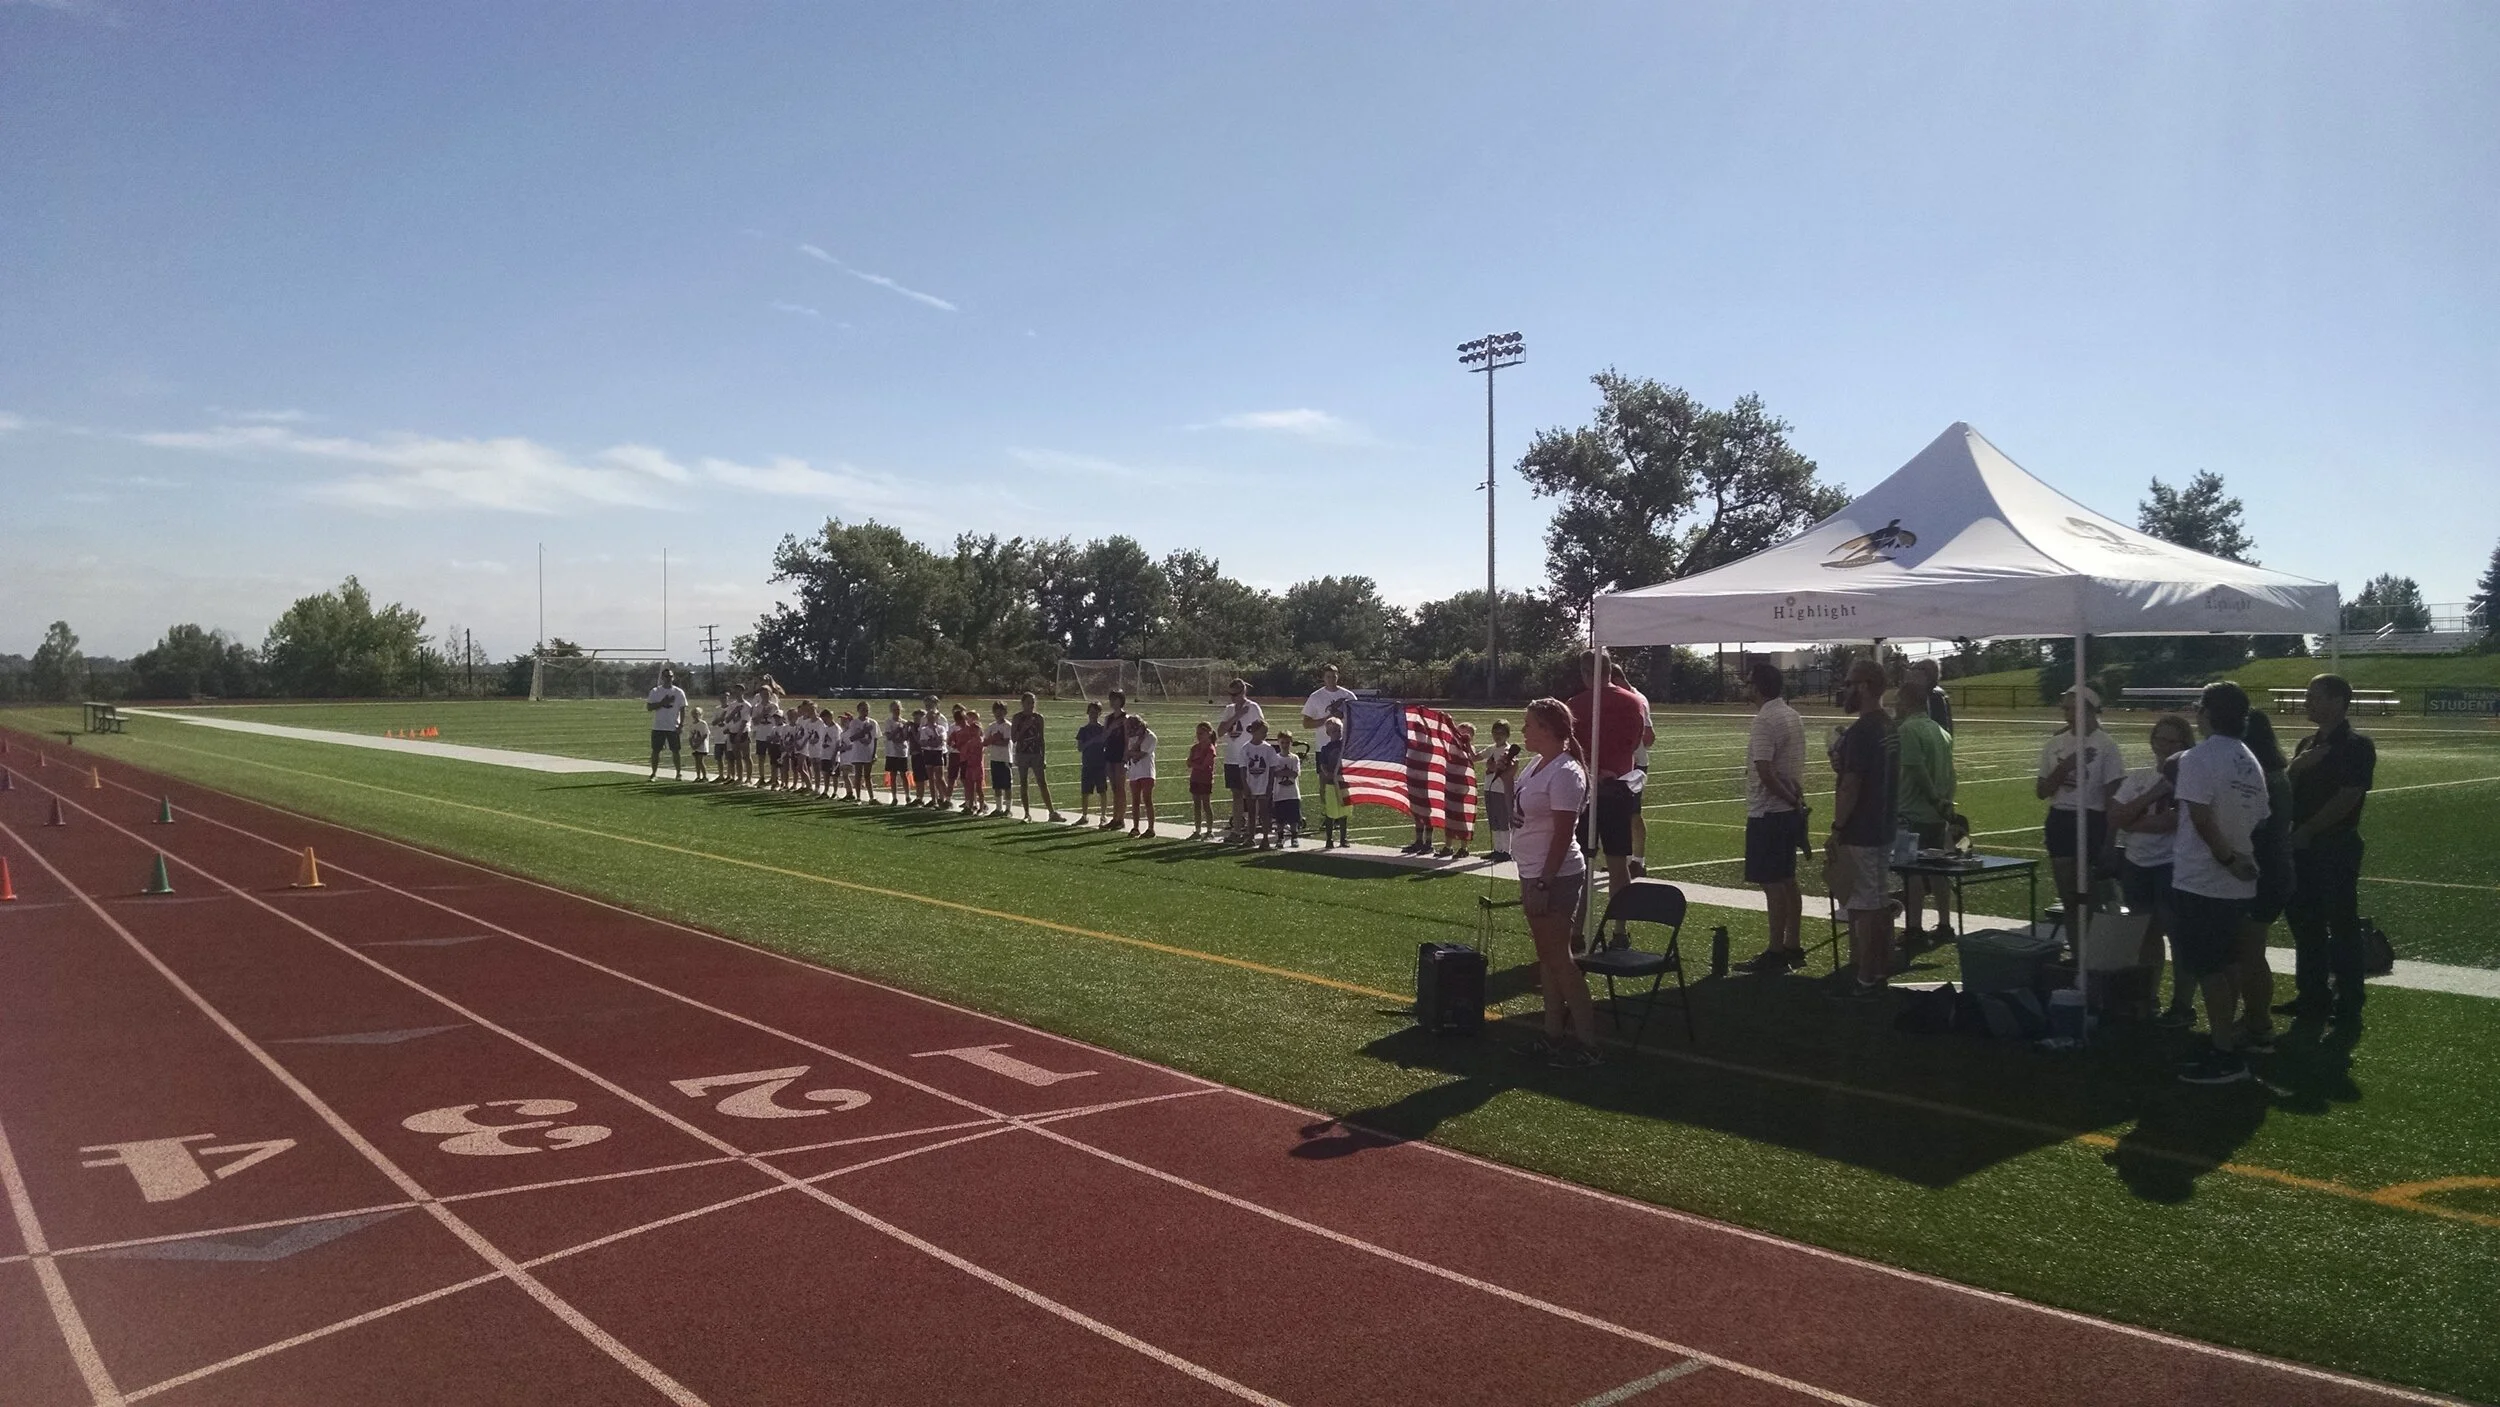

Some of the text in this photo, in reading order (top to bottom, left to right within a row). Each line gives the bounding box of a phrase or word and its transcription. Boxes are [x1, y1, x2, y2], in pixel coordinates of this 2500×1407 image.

[1774, 597, 1857, 621] Highlight
[2430, 699, 2496, 711] STUDENT
[911, 1043, 1099, 1087] 1
[670, 1066, 872, 1119] 2
[402, 1099, 613, 1156] 3
[80, 1133, 297, 1203] 4
